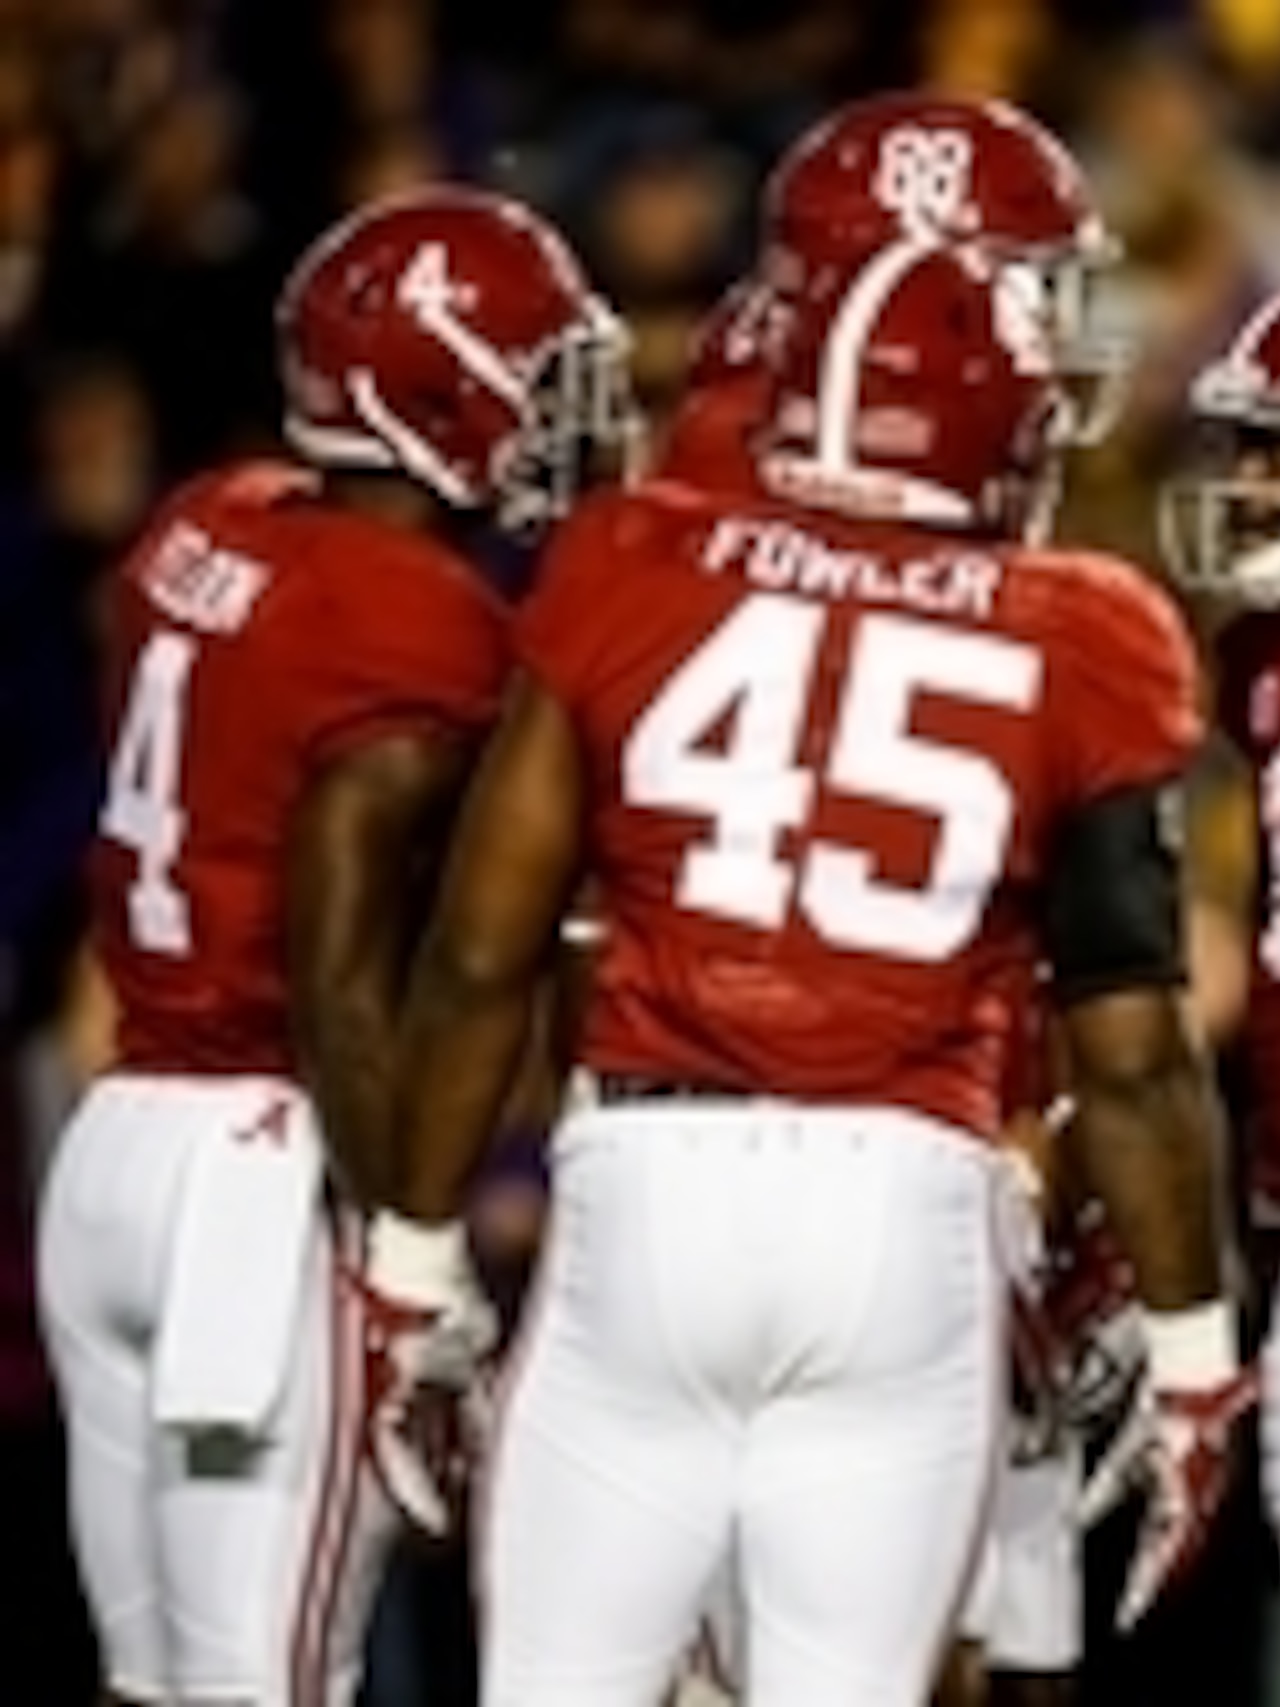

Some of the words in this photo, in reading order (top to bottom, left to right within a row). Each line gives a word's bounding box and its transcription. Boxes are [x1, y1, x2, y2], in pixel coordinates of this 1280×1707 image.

[870, 125, 973, 228] 88
[396, 238, 458, 314] 4
[704, 518, 1002, 620] FOWLER
[100, 630, 194, 957] 4
[622, 590, 1043, 962] 45
